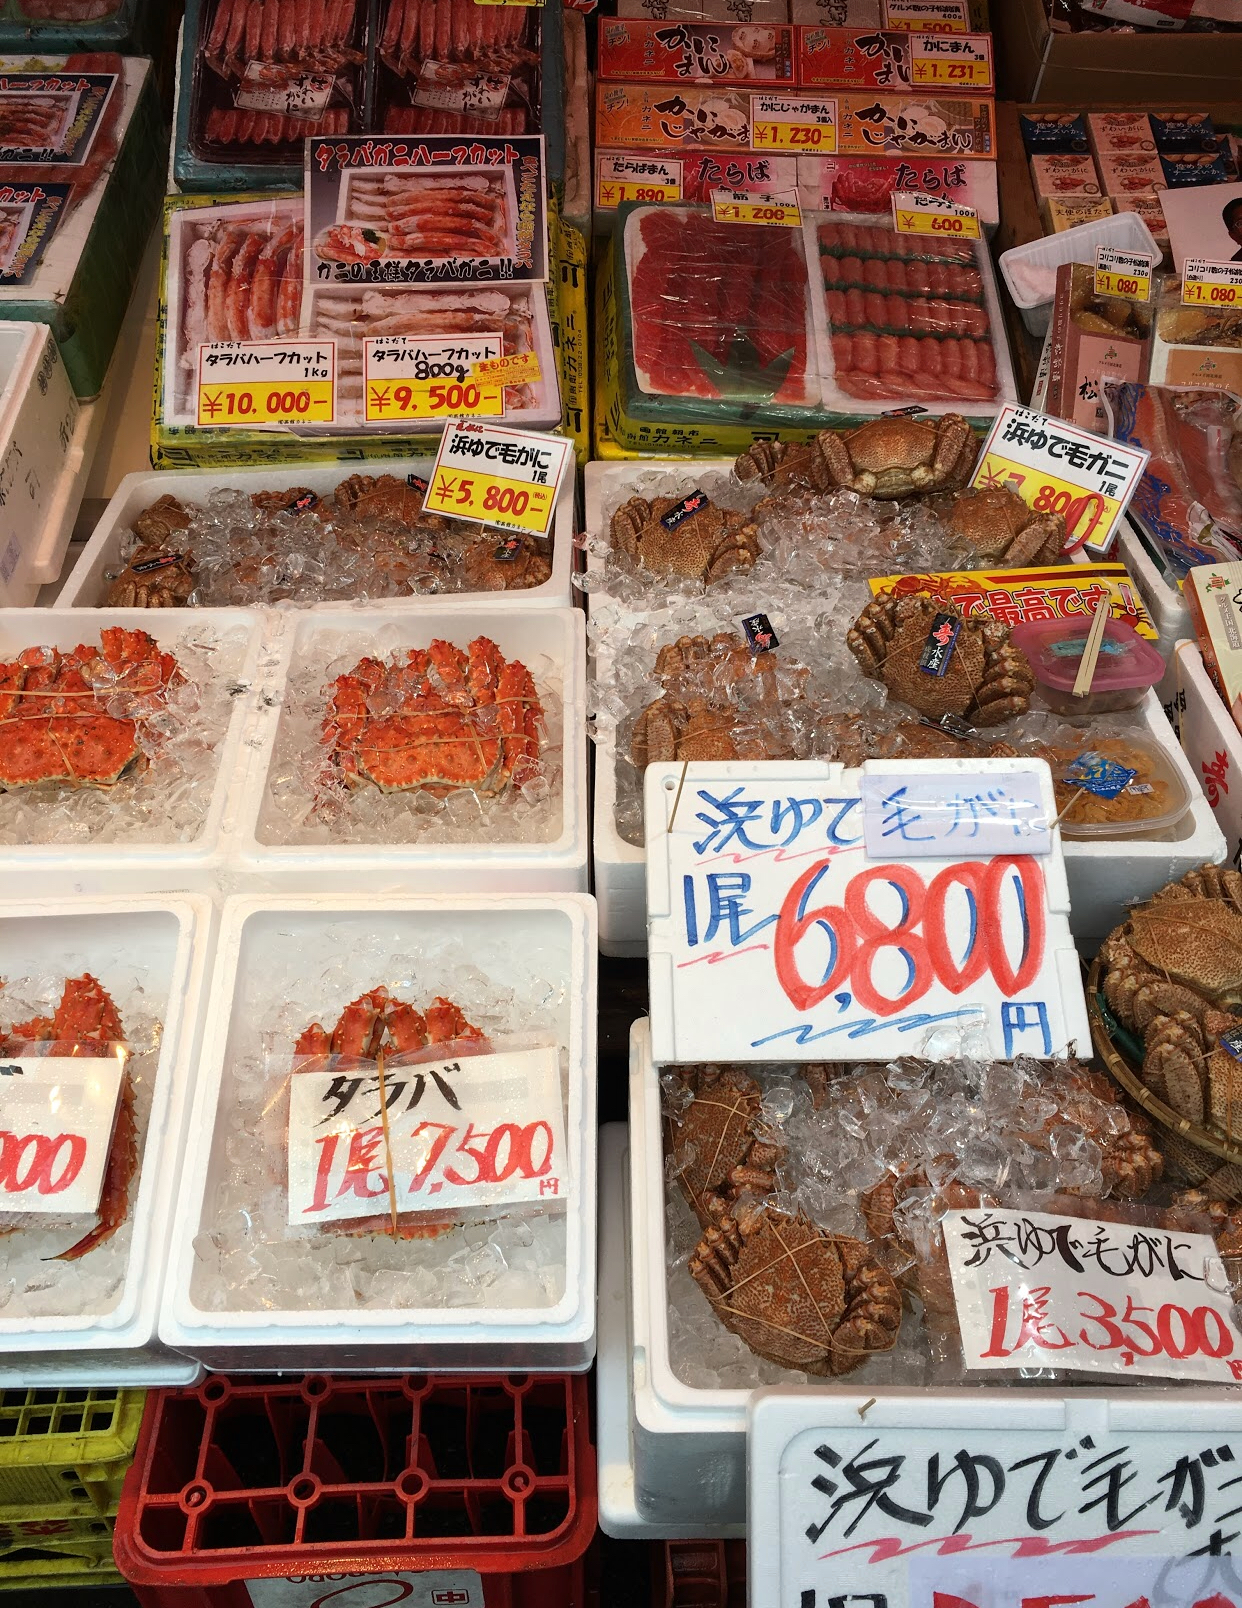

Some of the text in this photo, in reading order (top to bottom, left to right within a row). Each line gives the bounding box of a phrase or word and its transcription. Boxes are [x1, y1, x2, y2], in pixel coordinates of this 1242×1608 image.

[923, 39, 975, 54] かにまん
[760, 102, 830, 114] かにじゃがまん
[315, 140, 519, 171] タラバガニハーフカット
[613, 162, 669, 176] たらばまん
[699, 157, 771, 186] たらば
[894, 162, 967, 190] たらば
[1055, 208, 1111, 216] 天使のほたて
[205, 351, 328, 367] タラバハーフカット
[372, 347, 496, 362] タラバハーフカット
[479, 353, 529, 373] 生ものです
[304, 367, 328, 378] 1kg
[414, 361, 469, 383] 800g
[449, 434, 552, 470] 浜ゆで毛がに
[1001, 418, 1129, 481] 浜ゆで毛ガニ
[532, 470, 547, 484] 1尾
[1099, 480, 1118, 497] 1尾
[938, 584, 1137, 630] で最高です!
[773, 853, 1046, 1019] 6,800
[1000, 1001, 1053, 1060] 円
[317, 1062, 465, 1128] タラバ
[960, 1213, 1205, 1282] 浜ゆで毛がに
